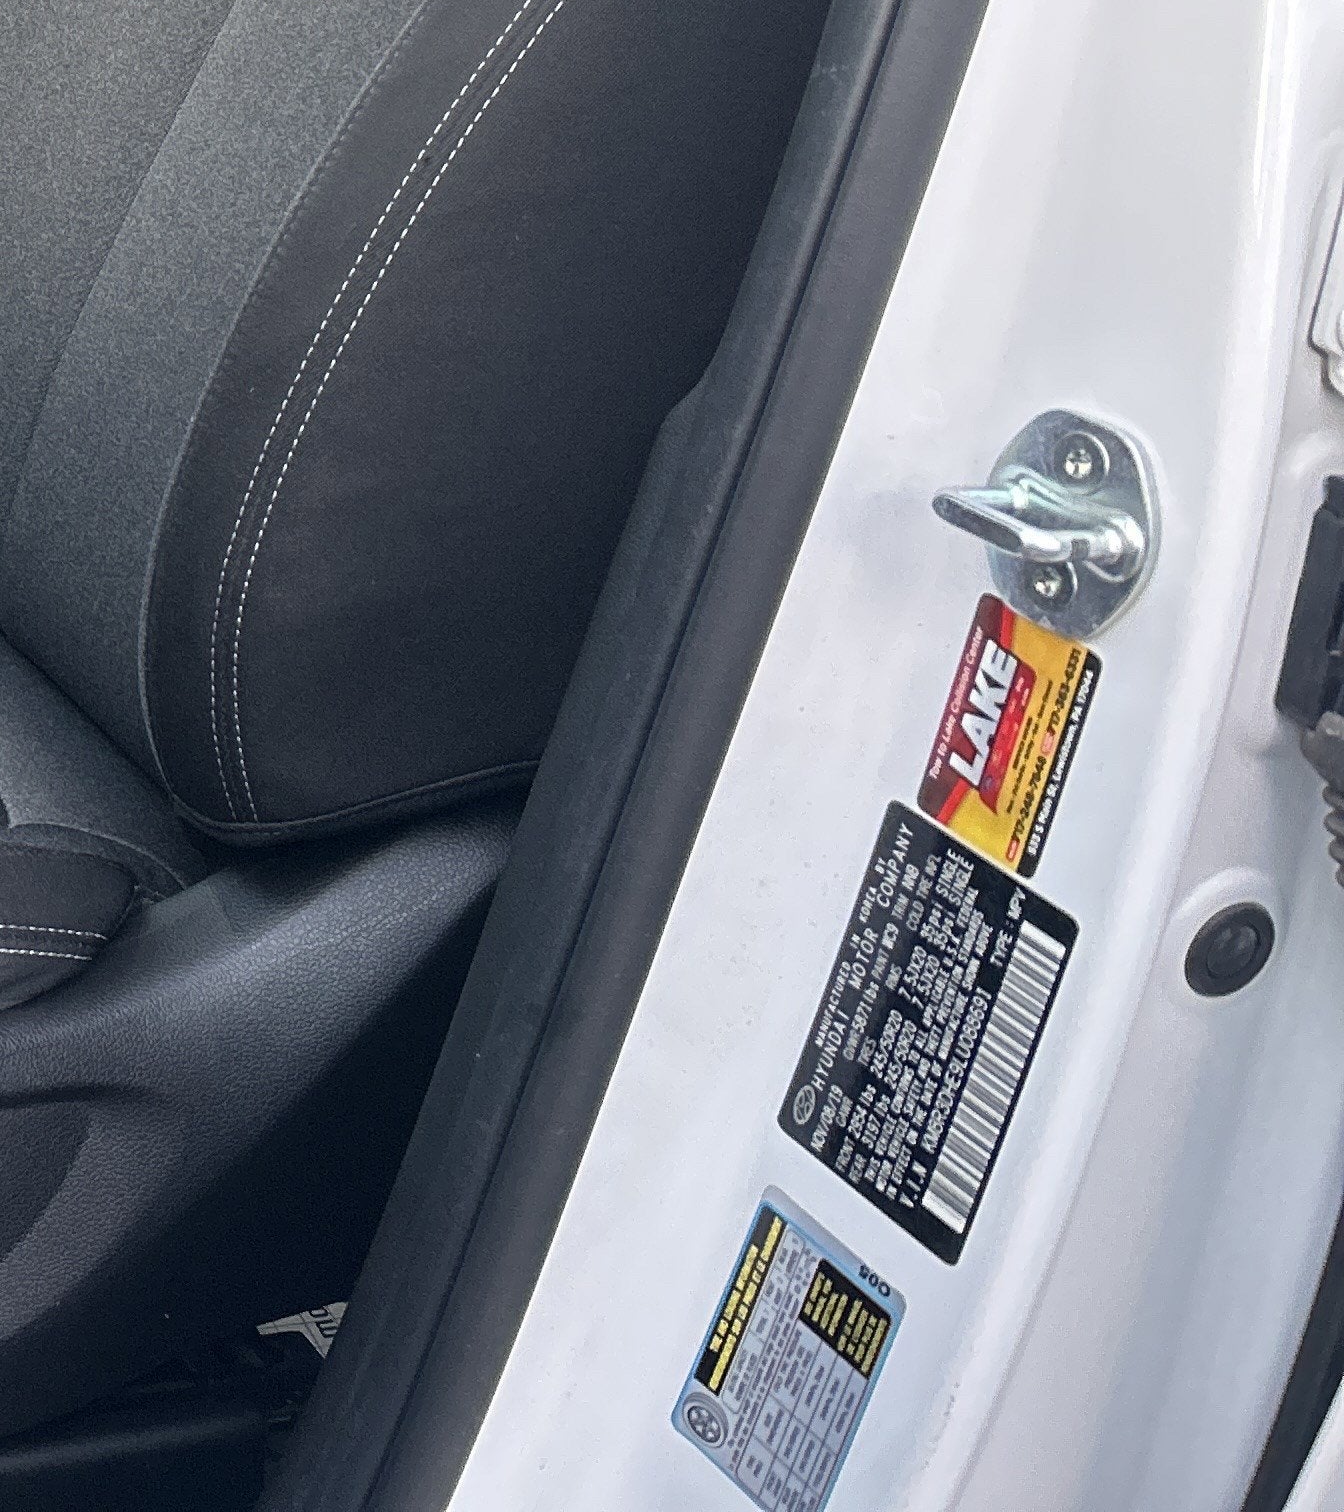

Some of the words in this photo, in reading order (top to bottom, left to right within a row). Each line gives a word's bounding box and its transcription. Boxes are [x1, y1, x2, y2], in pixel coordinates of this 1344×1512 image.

[964, 624, 985, 665] Center
[945, 637, 1022, 787] LAKE
[949, 664, 972, 713] Collision
[936, 740, 948, 756] to
[940, 713, 957, 742] Lake
[928, 754, 943, 780] Tow
[812, 959, 852, 1048] MANUFACTURED
[849, 932, 861, 949] IN
[857, 883, 878, 923] KOREA
[874, 855, 888, 875] BY
[904, 898, 925, 932] COLD
[988, 927, 1013, 969] TYPE
[1005, 885, 1028, 922] MPV
[810, 1008, 850, 1092] HYUNDAI
[846, 925, 880, 990] MOTOR
[873, 821, 916, 909] COMPANY
[834, 1134, 856, 1174] FRONT
[868, 1007, 904, 1079] 245/50R20
[933, 847, 962, 899] SINGLE
[847, 1151, 867, 1184] REAR
[882, 1017, 918, 1090] 245/50R20
[946, 855, 975, 907] SINGLE
[809, 1081, 844, 1154] NOV/08/19
